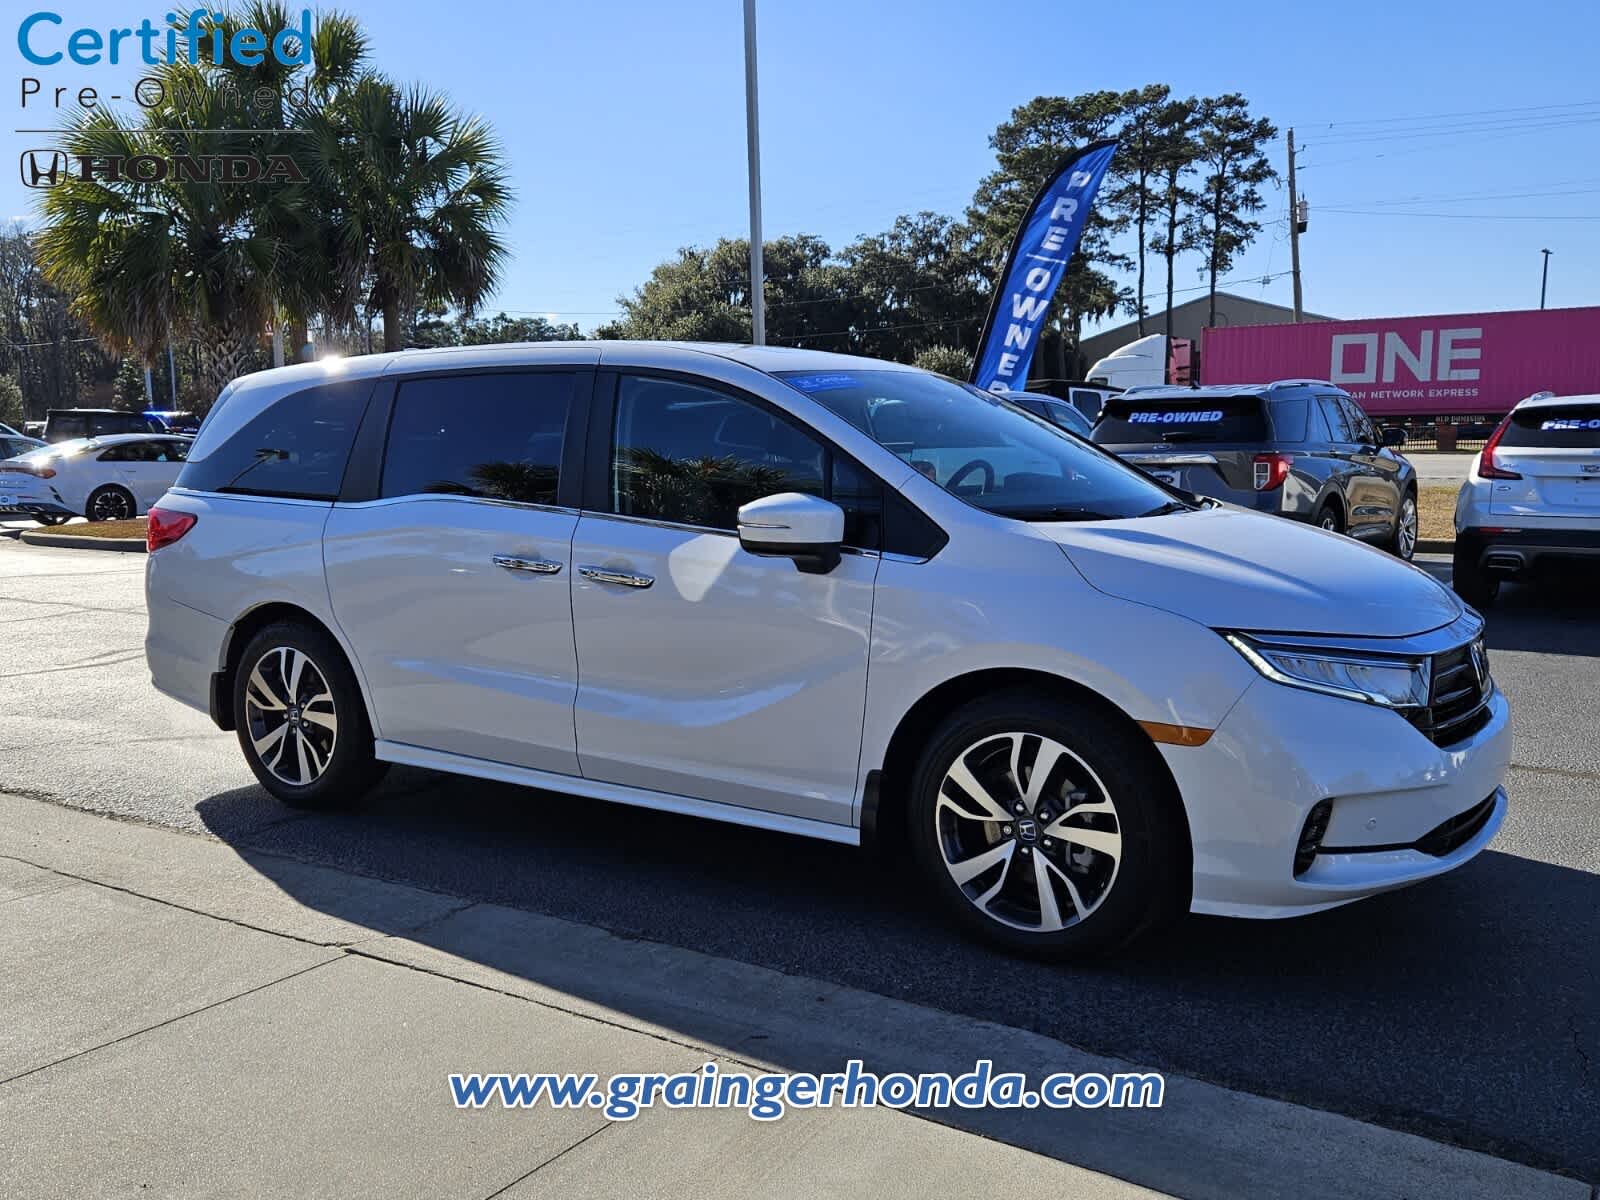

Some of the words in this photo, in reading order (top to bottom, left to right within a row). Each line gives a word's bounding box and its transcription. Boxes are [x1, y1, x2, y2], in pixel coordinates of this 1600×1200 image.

[1329, 327, 1483, 384] ONE
[1370, 389, 1425, 399] NETWORK
[1428, 387, 1480, 397] EXPRESS
[1127, 410, 1223, 423] PRE-OWNED
